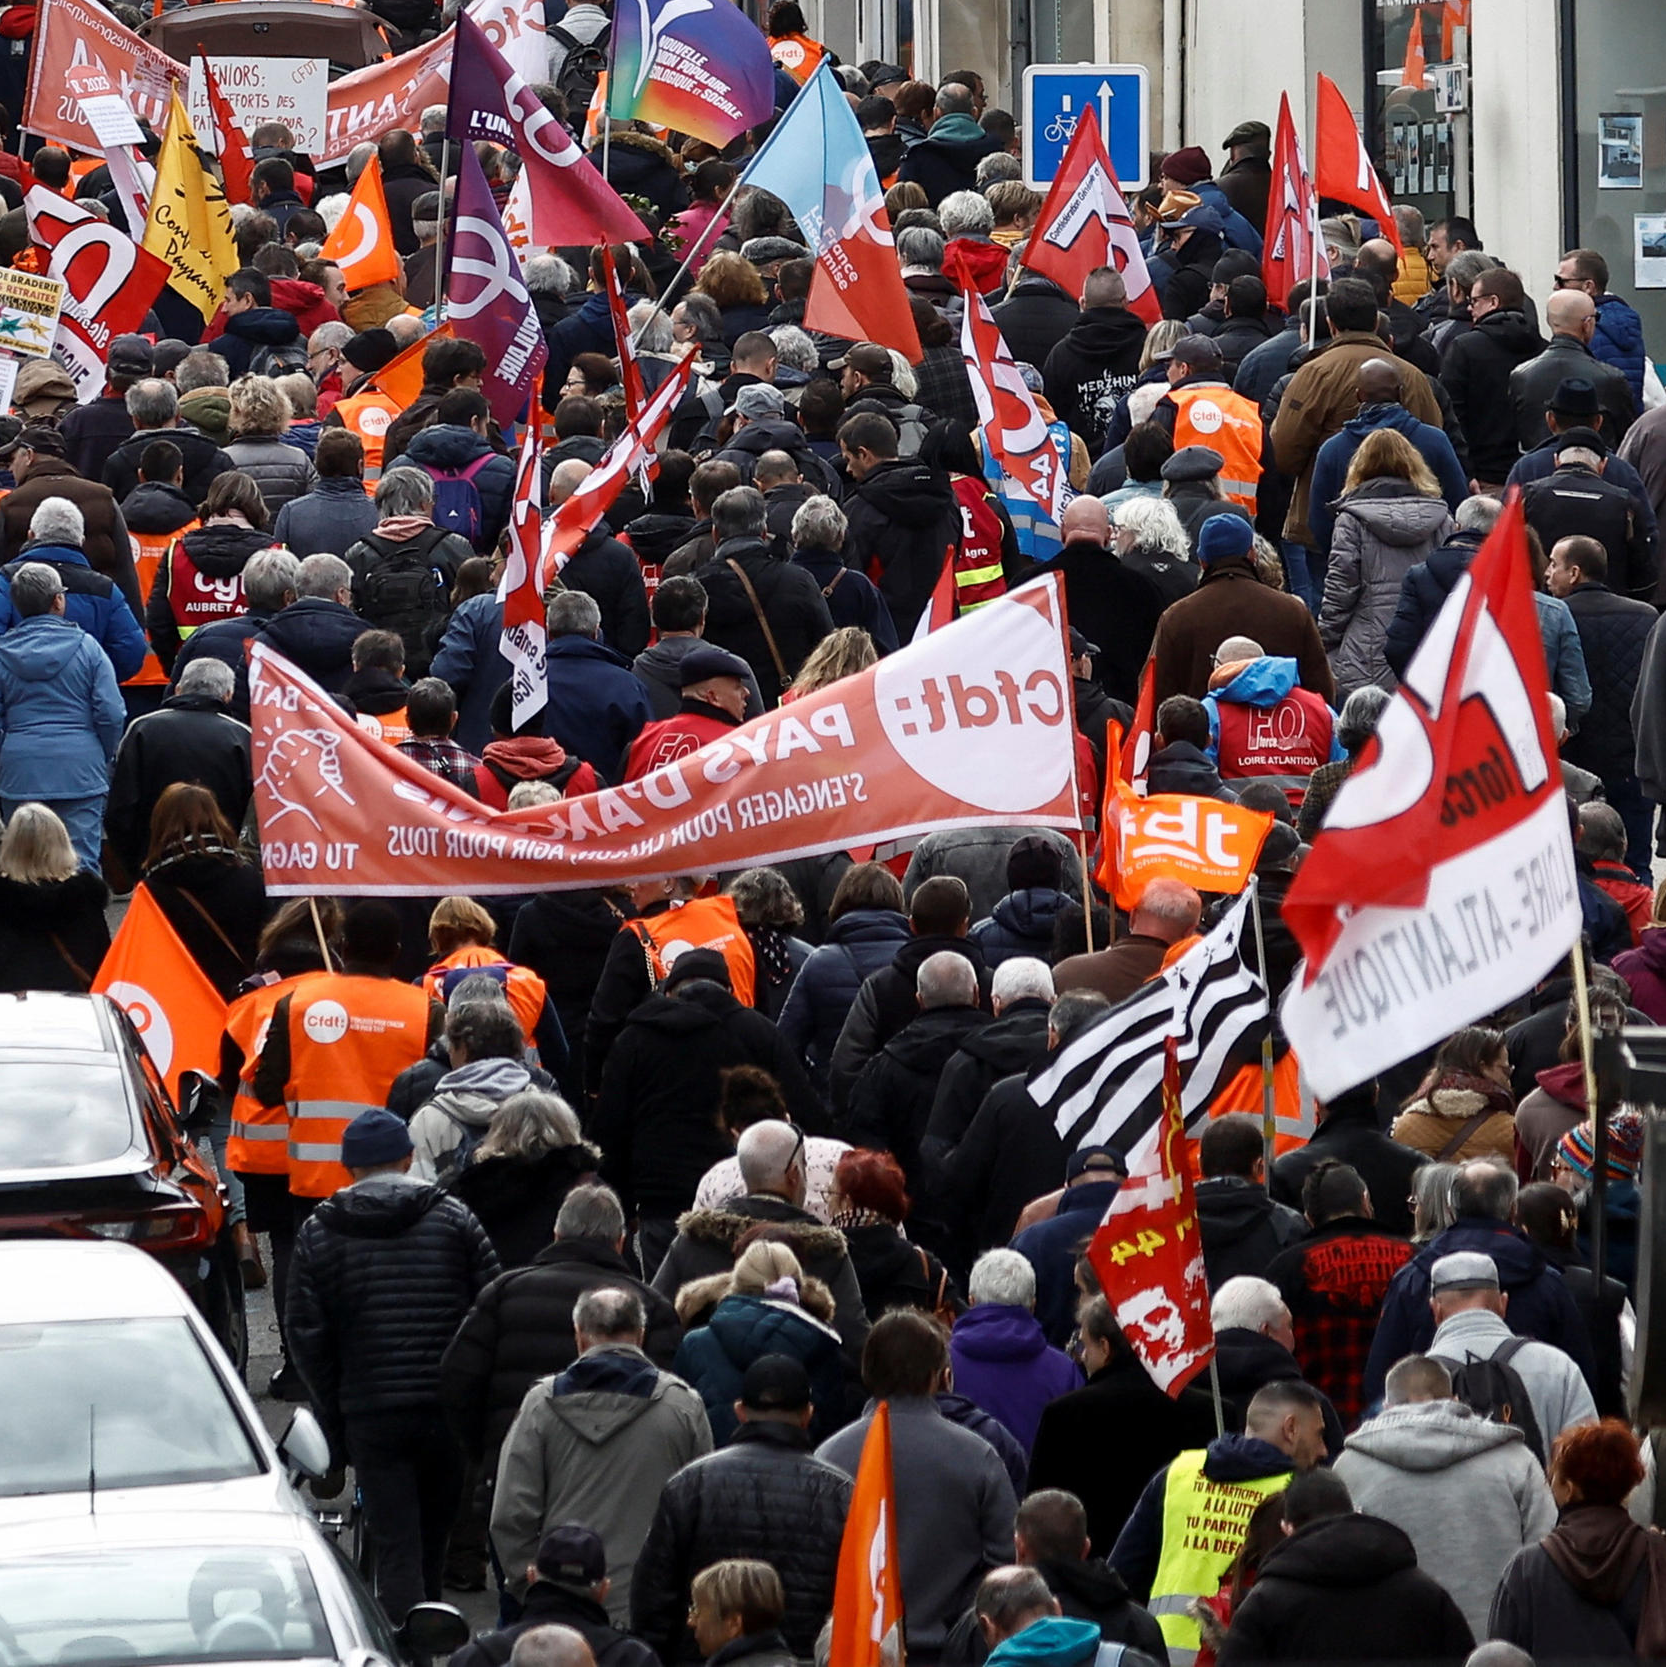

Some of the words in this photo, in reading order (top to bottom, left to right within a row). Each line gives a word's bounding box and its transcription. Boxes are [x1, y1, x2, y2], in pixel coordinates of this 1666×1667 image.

[291, 59, 318, 84] CFDT
[678, 55, 733, 95] POPULAIRE
[83, 76, 110, 92] 2023
[276, 94, 296, 110] DES
[700, 88, 745, 121] SOCIALE
[823, 225, 859, 283] France
[9, 273, 60, 294] BRADERIE
[2, 283, 57, 304] RETRAITES
[1077, 373, 1138, 395] MERZHIN
[964, 545, 989, 559] Agro
[185, 603, 234, 615] AUBRET
[1238, 755, 1267, 767] LOIRE
[307, 1012, 347, 1029] Cfdt:
[1213, 1498, 1228, 1513] LA
[1187, 1515, 1201, 1529] TU
[1193, 1535, 1210, 1550] LA
